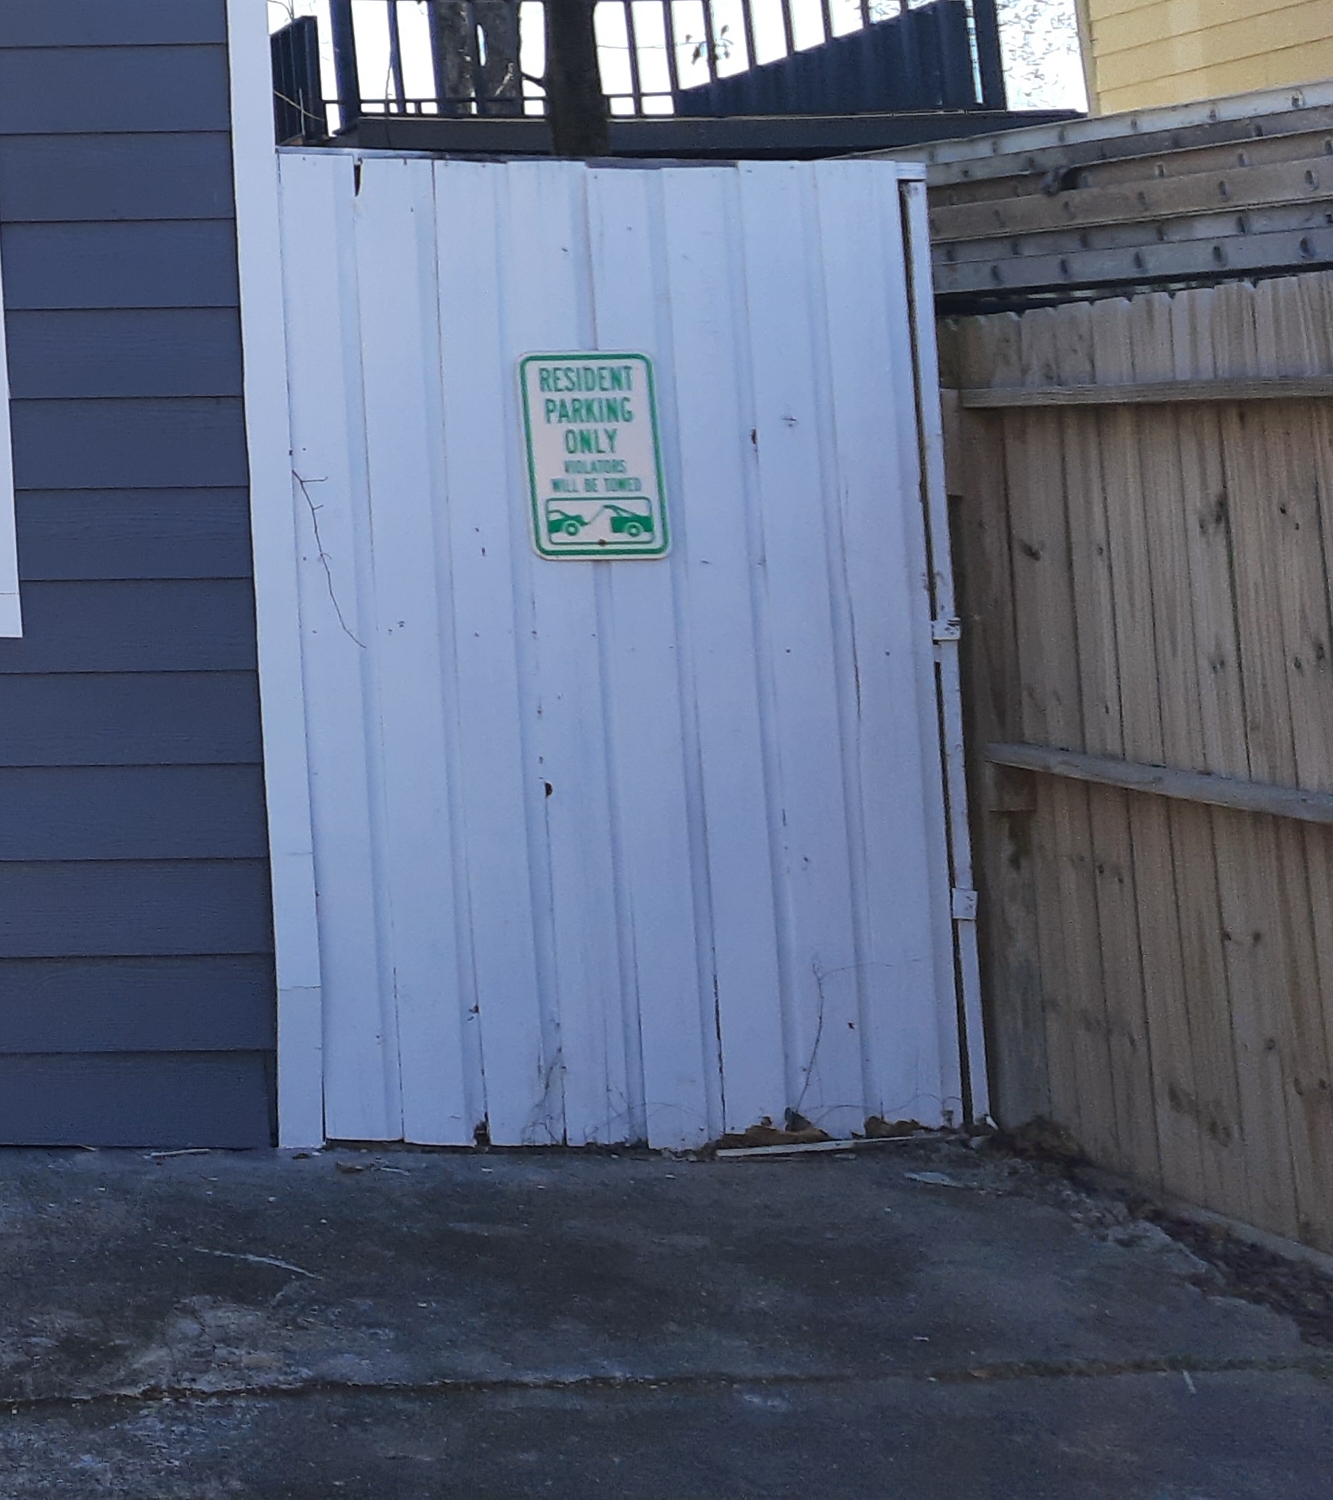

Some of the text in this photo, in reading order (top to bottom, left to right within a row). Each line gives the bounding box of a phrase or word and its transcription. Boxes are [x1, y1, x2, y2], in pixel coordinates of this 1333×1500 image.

[538, 366, 633, 393] RESIDENT
[545, 397, 634, 424] PARKING
[565, 428, 618, 454] ONLY
[564, 459, 627, 474] VIOLATORS
[550, 477, 642, 493] WILL BE TOWED
